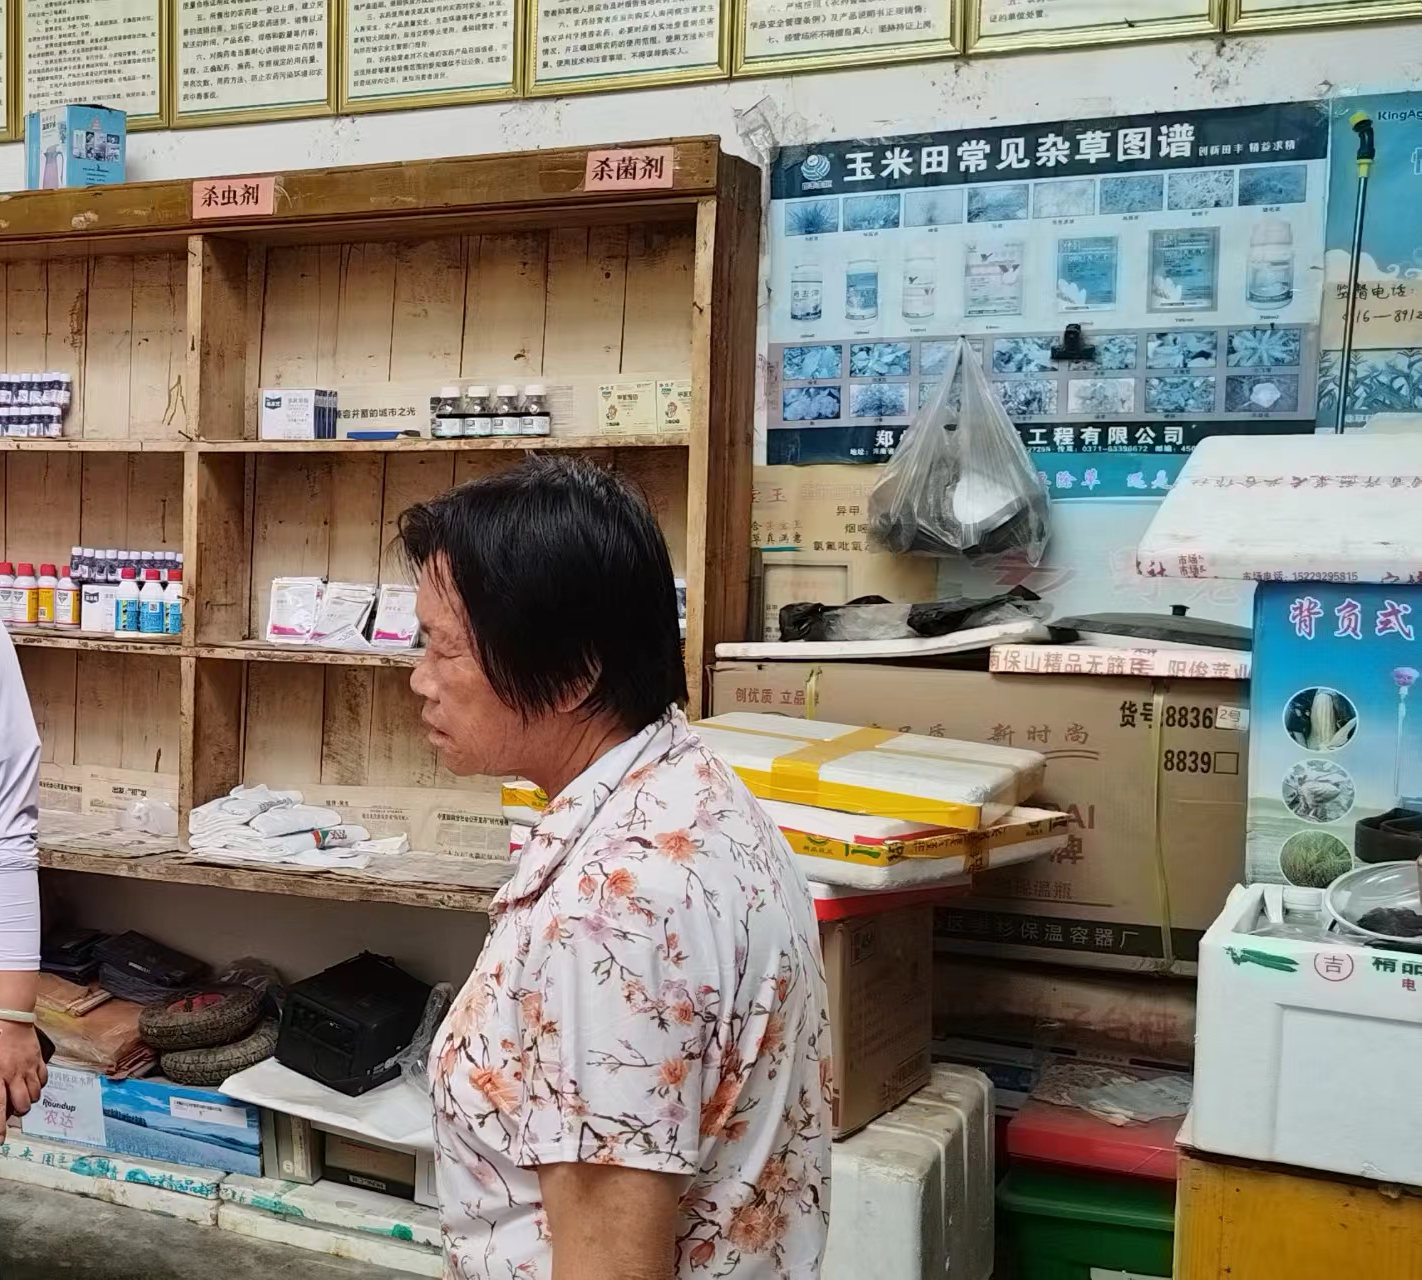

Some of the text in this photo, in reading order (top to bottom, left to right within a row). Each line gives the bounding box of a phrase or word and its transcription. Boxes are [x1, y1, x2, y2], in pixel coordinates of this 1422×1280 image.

[843, 123, 1195, 182] 玉米田常见杂草图谱
[590, 155, 664, 181] 杀菌剂
[200, 183, 260, 207] 杀虫剂
[1289, 597, 1415, 641] 背负式
[735, 687, 820, 707] 创优质 立品
[987, 723, 1091, 746] 新时尚
[1163, 750, 1212, 774] 8839
[1324, 955, 1344, 974] 吉
[1402, 978, 1417, 992] 电
[42, 1098, 76, 1112] Roundup
[44, 1109, 75, 1128] 农达
